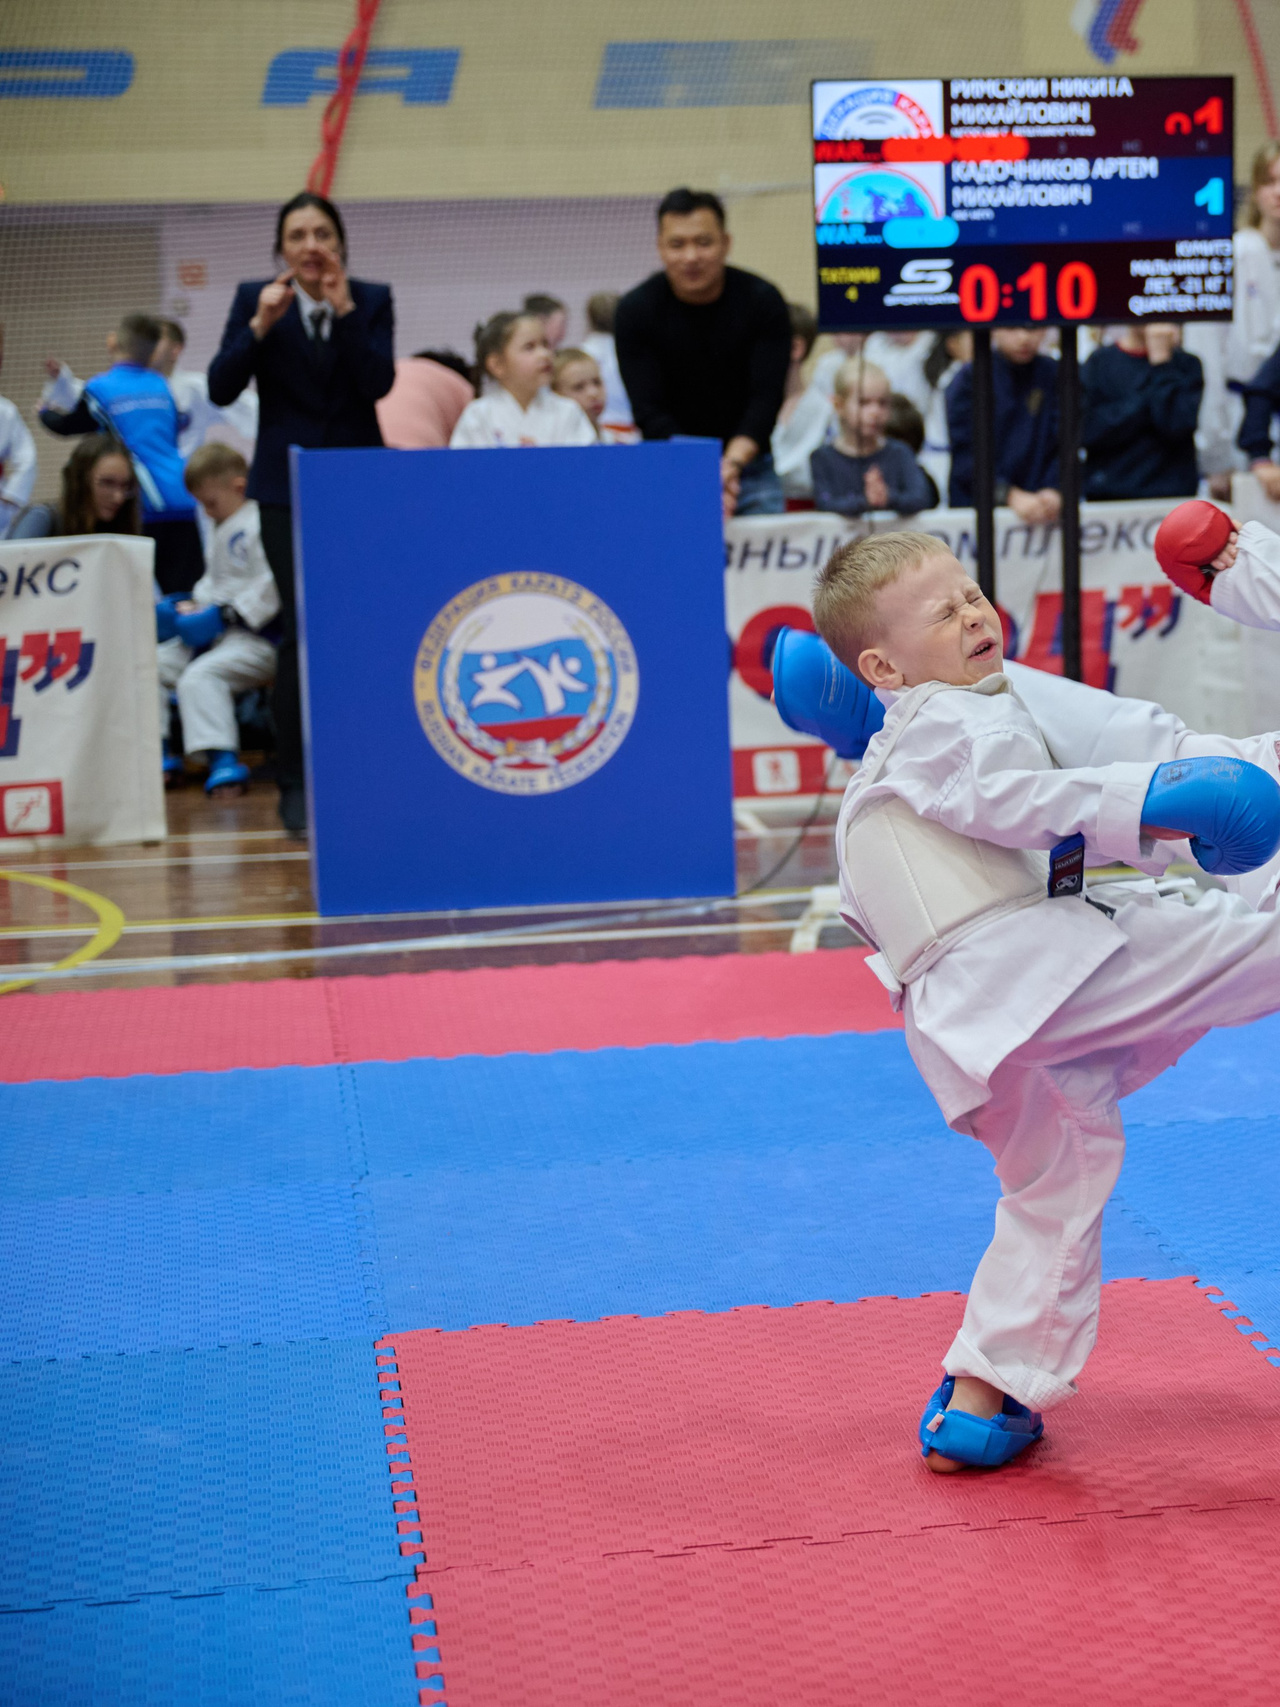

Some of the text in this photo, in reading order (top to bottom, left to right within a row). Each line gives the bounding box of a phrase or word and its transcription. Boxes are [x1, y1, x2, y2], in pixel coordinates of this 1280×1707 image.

[951, 182, 1092, 207] МИХАЙЛОВИЧ
[1194, 177, 1224, 215] 1
[959, 261, 1097, 322] 0:10
